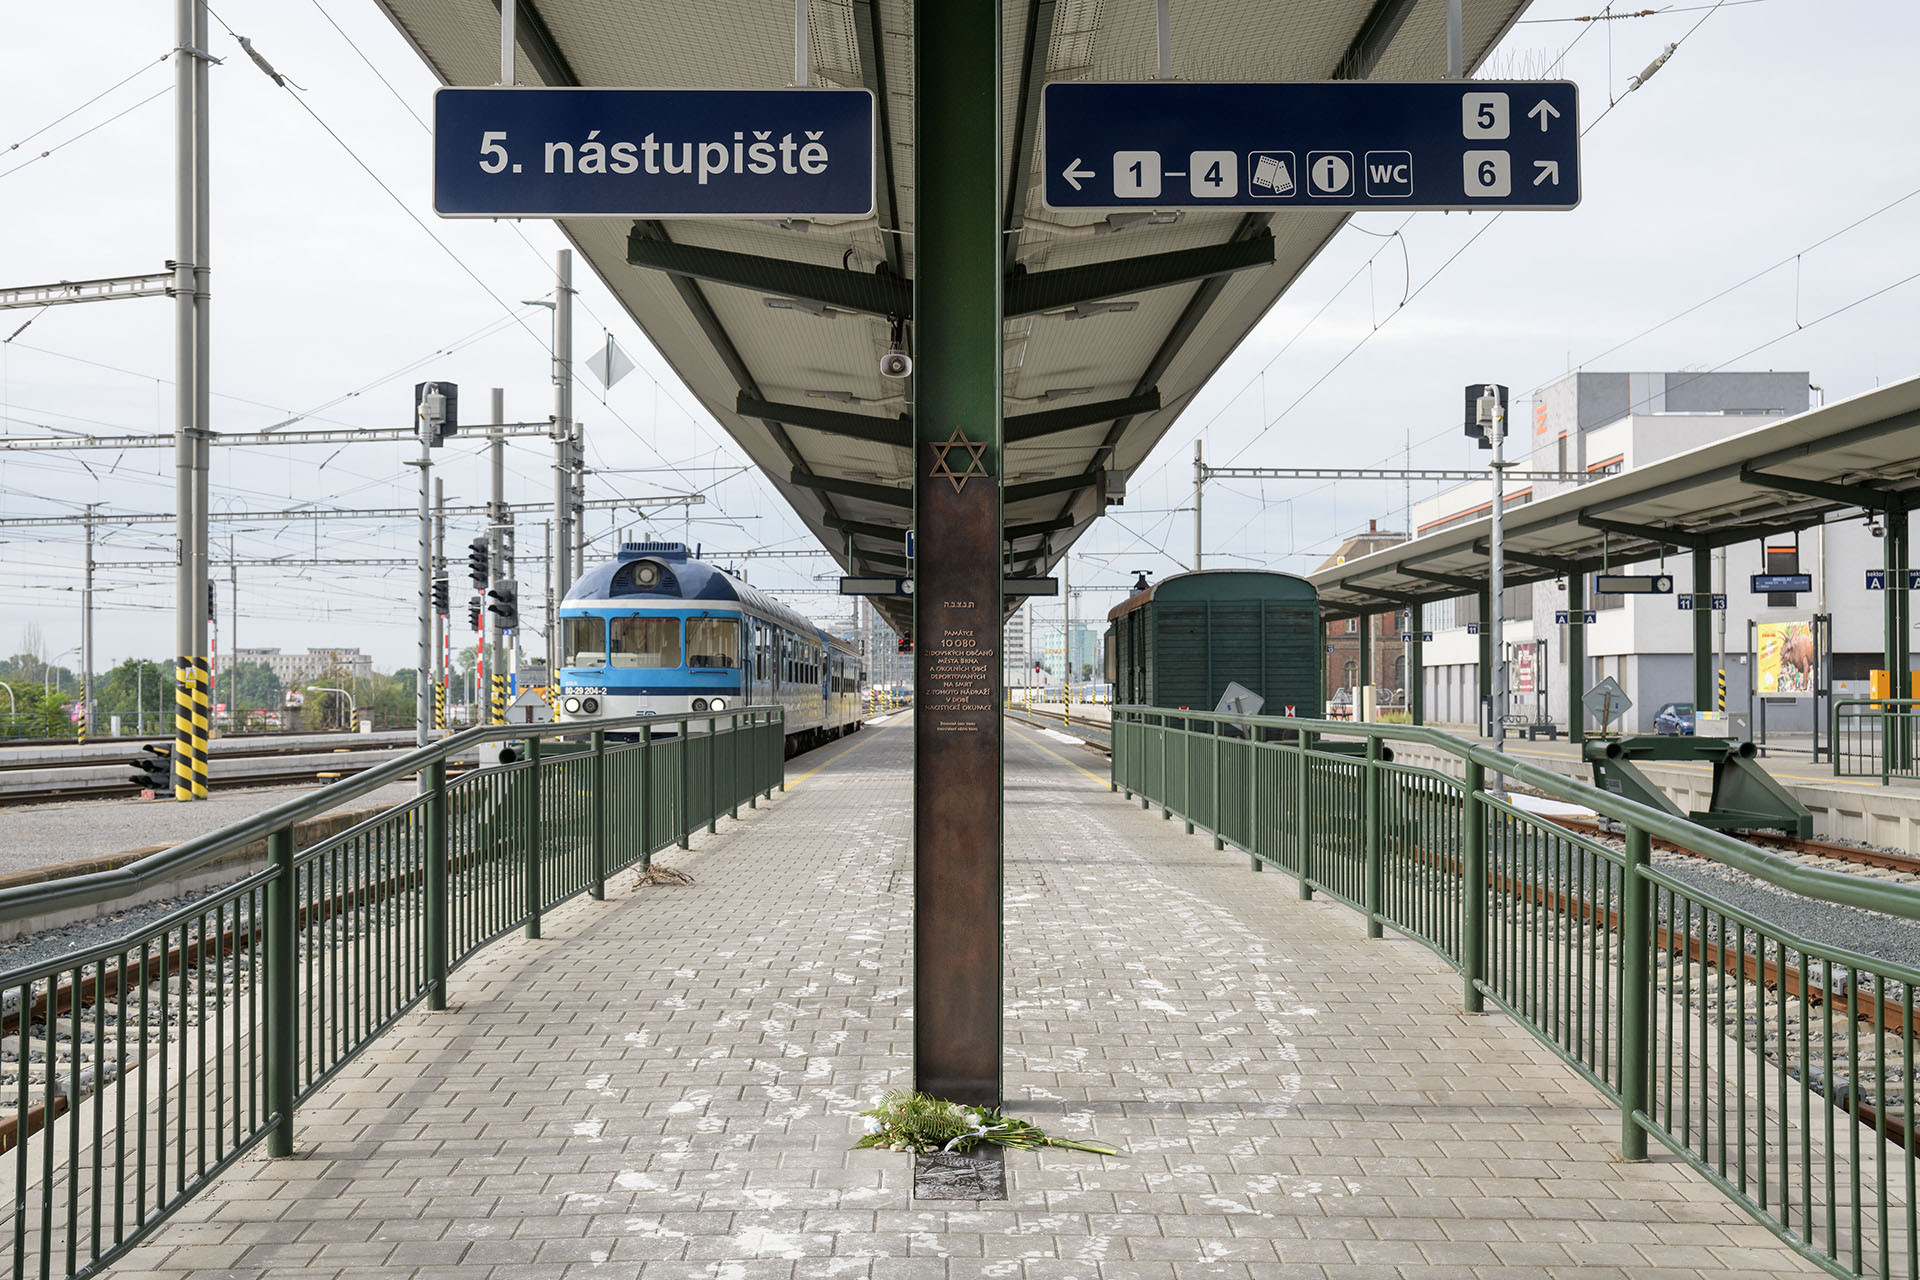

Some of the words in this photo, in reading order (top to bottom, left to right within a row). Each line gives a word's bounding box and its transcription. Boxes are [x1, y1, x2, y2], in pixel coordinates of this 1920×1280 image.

[1477, 103, 1495, 130] 5
[479, 131, 523, 174] 5.
[544, 130, 829, 185] nástupiště
[1370, 164, 1408, 185] WC
[1477, 161, 1496, 187] 6
[1870, 578, 1881, 589] A
[1680, 599, 1690, 609] 11
[1713, 599, 1726, 609] 13
[1558, 615, 1566, 624] A
[1586, 615, 1594, 624] A
[944, 629, 974, 637] PAMÁTCE
